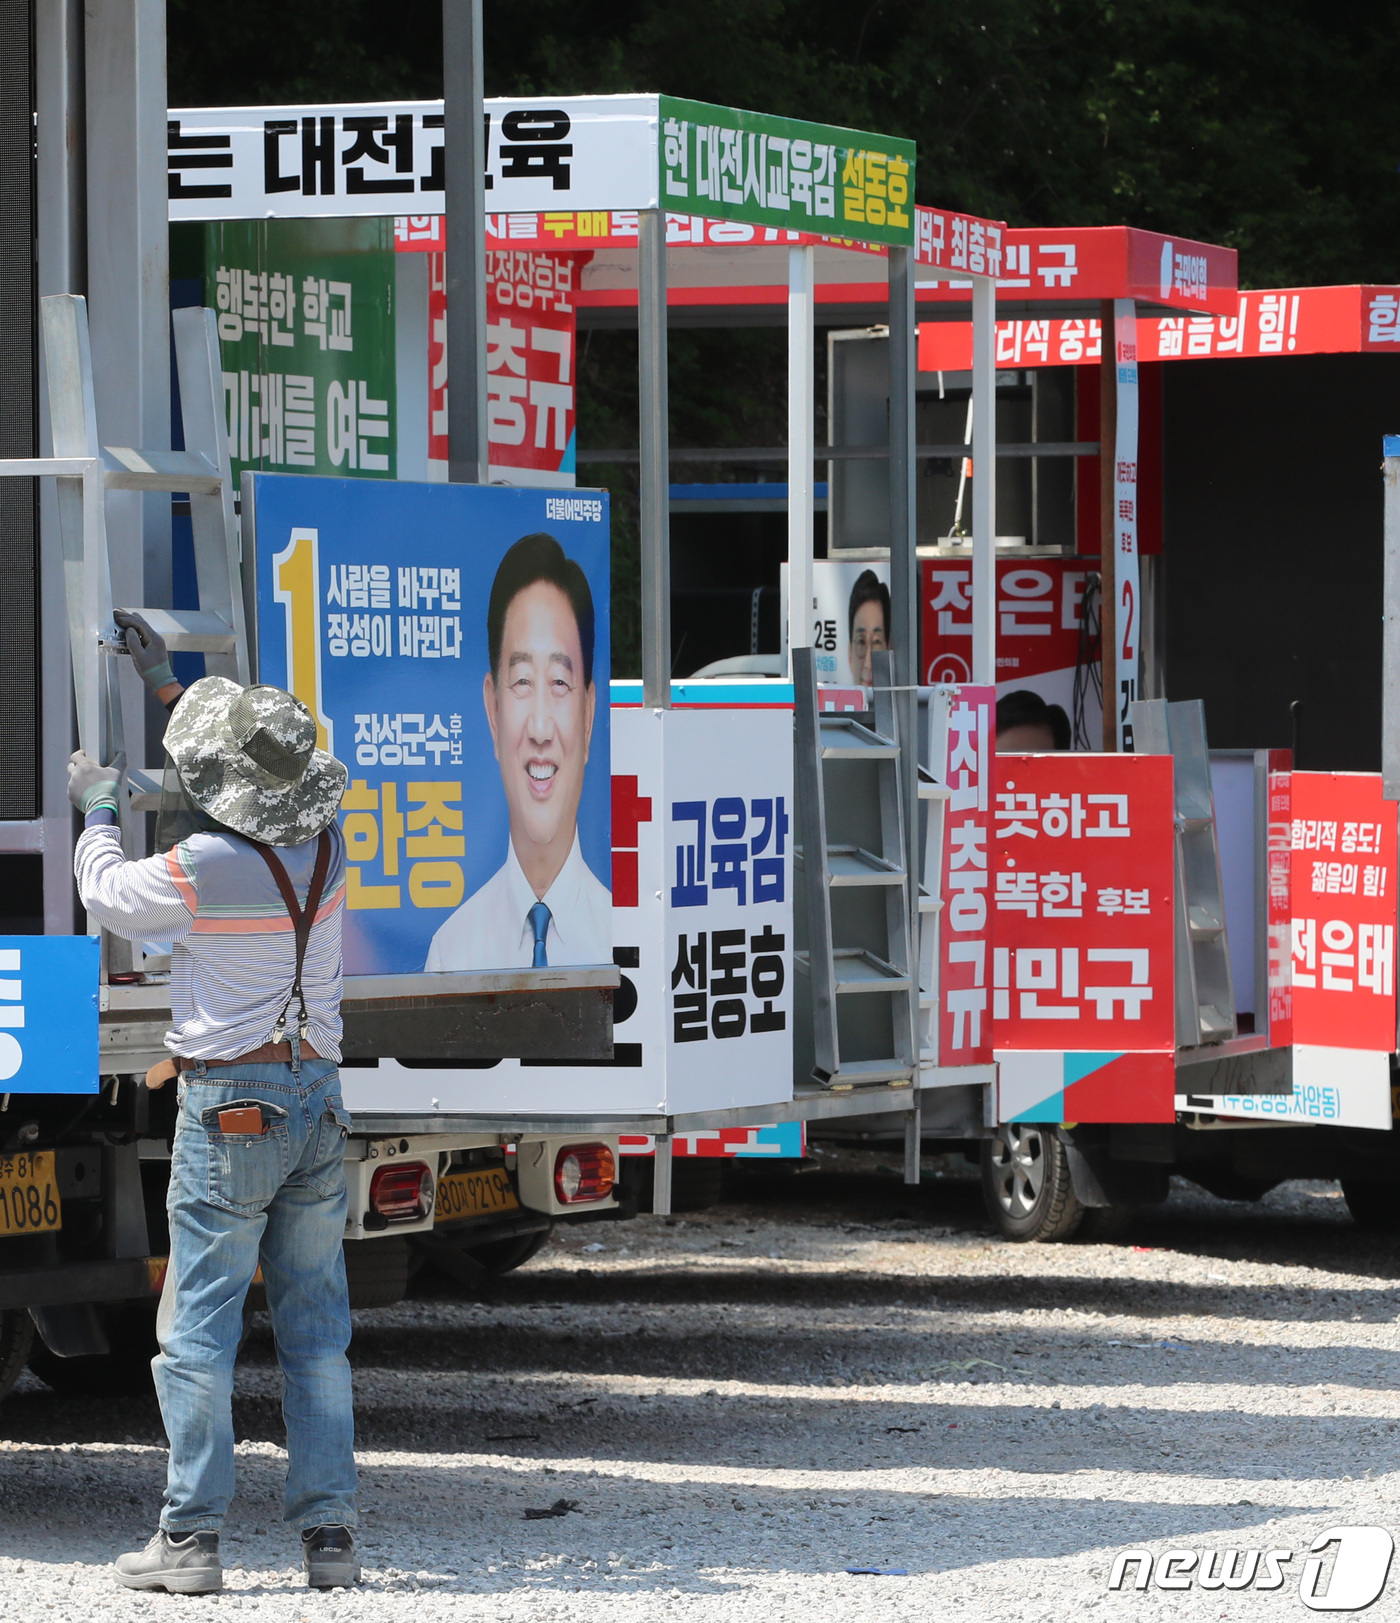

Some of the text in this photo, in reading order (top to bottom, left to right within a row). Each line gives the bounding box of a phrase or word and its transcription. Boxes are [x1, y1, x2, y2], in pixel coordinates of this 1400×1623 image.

[663, 117, 909, 228] 현 대전시교육감 설동호
[951, 217, 1003, 277] 최충규
[1174, 253, 1207, 301] 국민의힘
[216, 266, 353, 352] 행복한 학교
[1258, 295, 1299, 352] 힘!
[327, 379, 389, 471] 여는
[545, 497, 603, 522] 더불어민주당
[327, 564, 461, 611] 사람을 바꾸면
[327, 613, 463, 659] 장성이 바뀐다
[1122, 579, 1134, 660] 2
[354, 712, 463, 766] 장성군수 후보
[671, 796, 789, 908] 교육감
[1291, 818, 1382, 855] 합리적 중도!
[946, 701, 989, 1051] 최충규
[1096, 887, 1151, 917] 후보
[1311, 861, 1387, 897] 젊음의 힘!
[671, 925, 786, 1043] 설동호
[1291, 917, 1394, 997] 전은태
